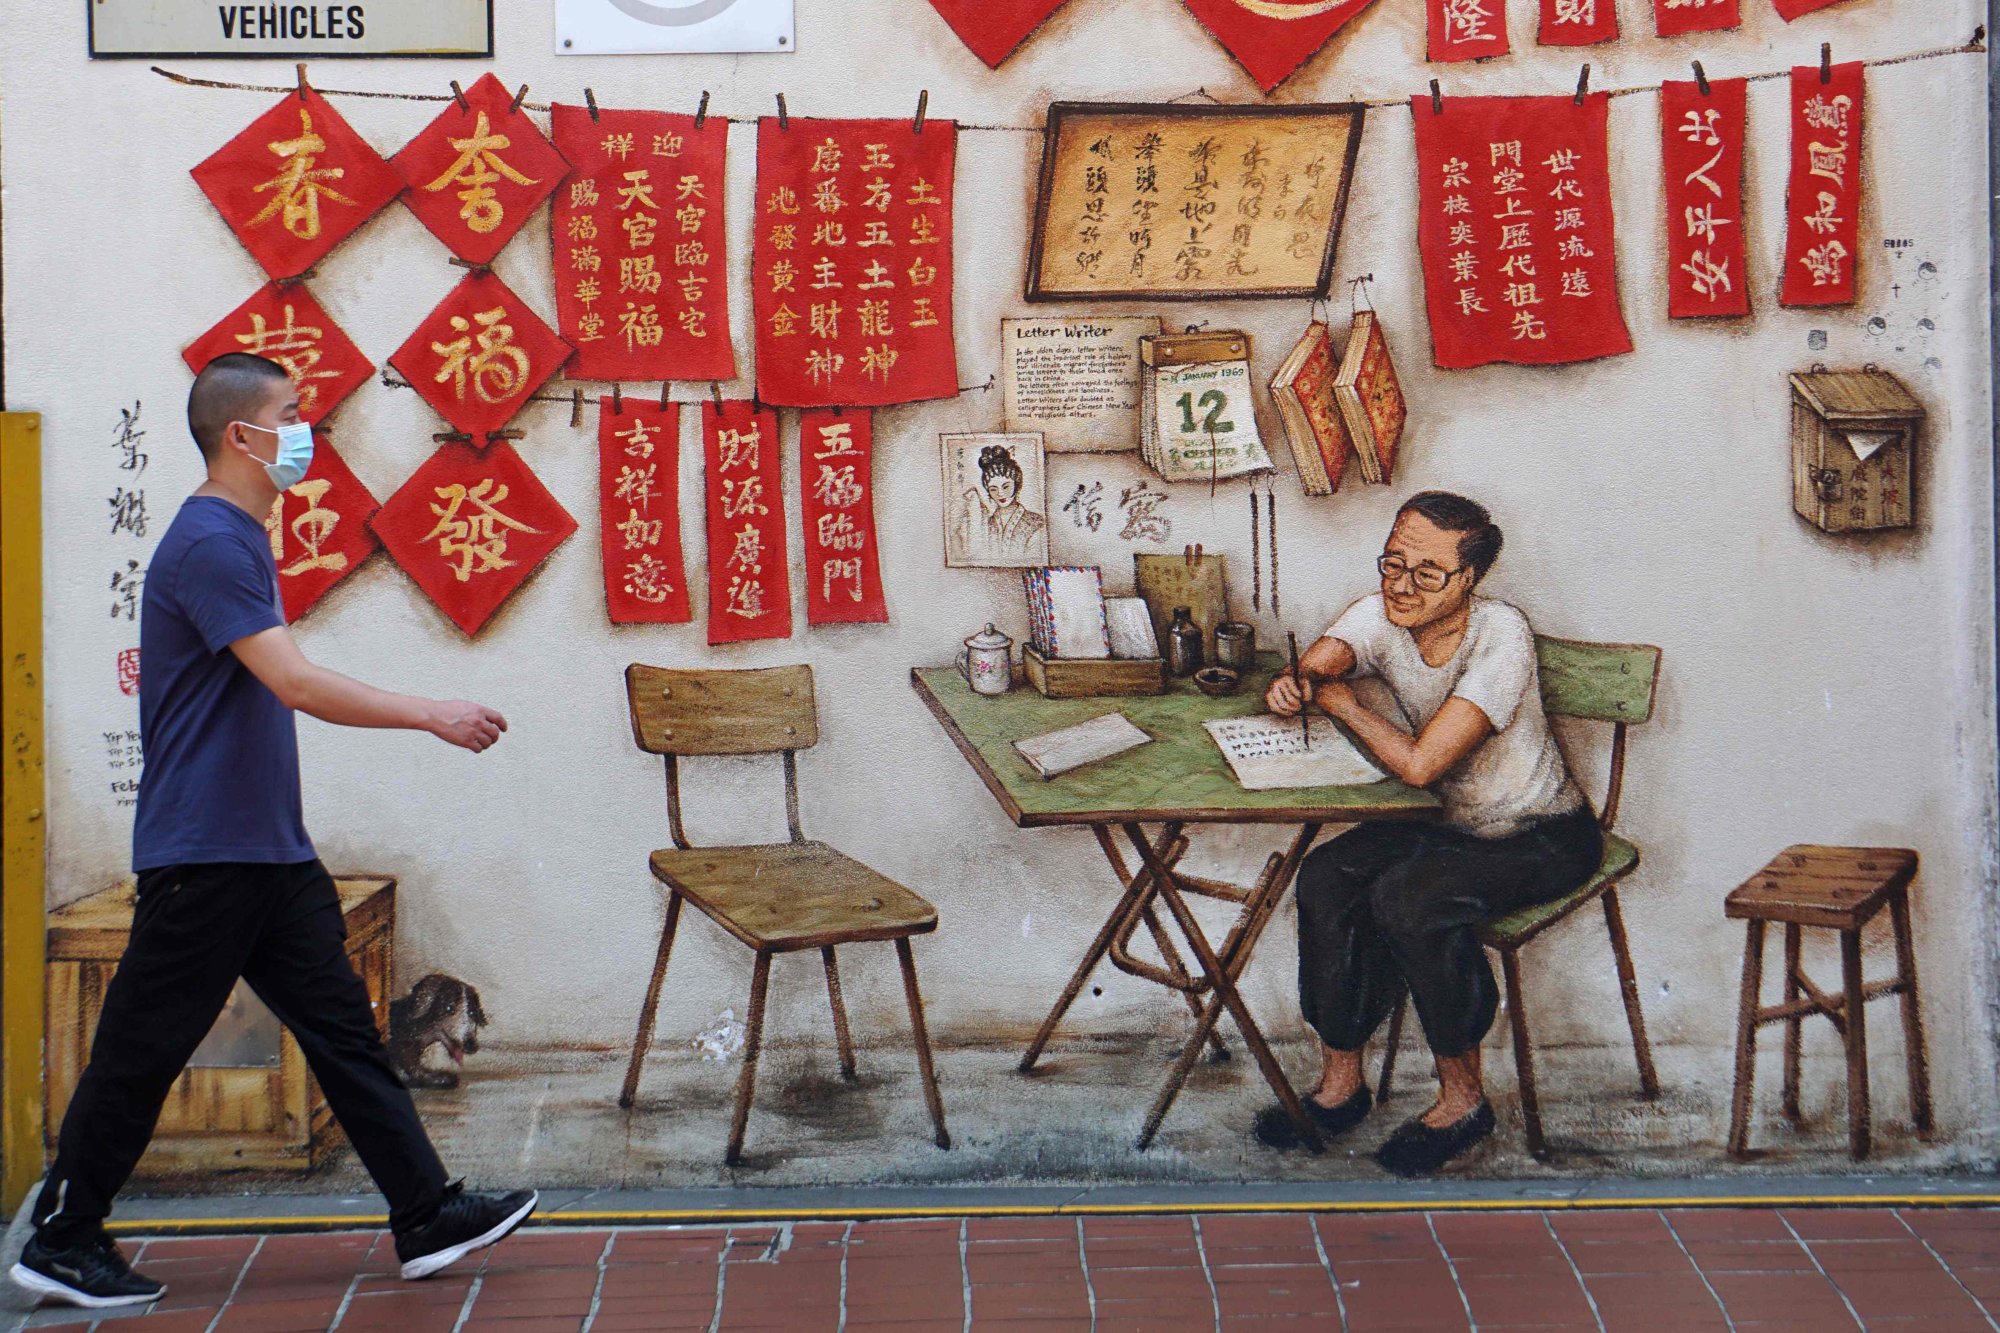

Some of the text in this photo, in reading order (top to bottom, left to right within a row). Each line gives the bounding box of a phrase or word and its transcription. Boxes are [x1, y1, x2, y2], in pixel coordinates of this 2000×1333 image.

[219, 5, 365, 39] VEHICLES
[244, 109, 358, 240] 春
[1541, 148, 1595, 298] 世代源流遠
[1678, 108, 1733, 303] 出入平安
[568, 178, 606, 343] 賜福滿華堂
[617, 169, 665, 353] 天官賜福
[675, 174, 709, 339] 天官臨吉宅
[431, 305, 531, 404] 福
[1016, 355, 1038, 364] played
[1017, 324, 1113, 339] Letter Writer
[1182, 367, 1245, 381] JANUARY 1969
[1175, 389, 1235, 433] 12
[415, 478, 548, 582] 發
[614, 418, 674, 603] 吉祥如意
[716, 421, 773, 620] 財源廣進
[812, 422, 866, 603] 五福臨門
[103, 731, 123, 744] Yip
